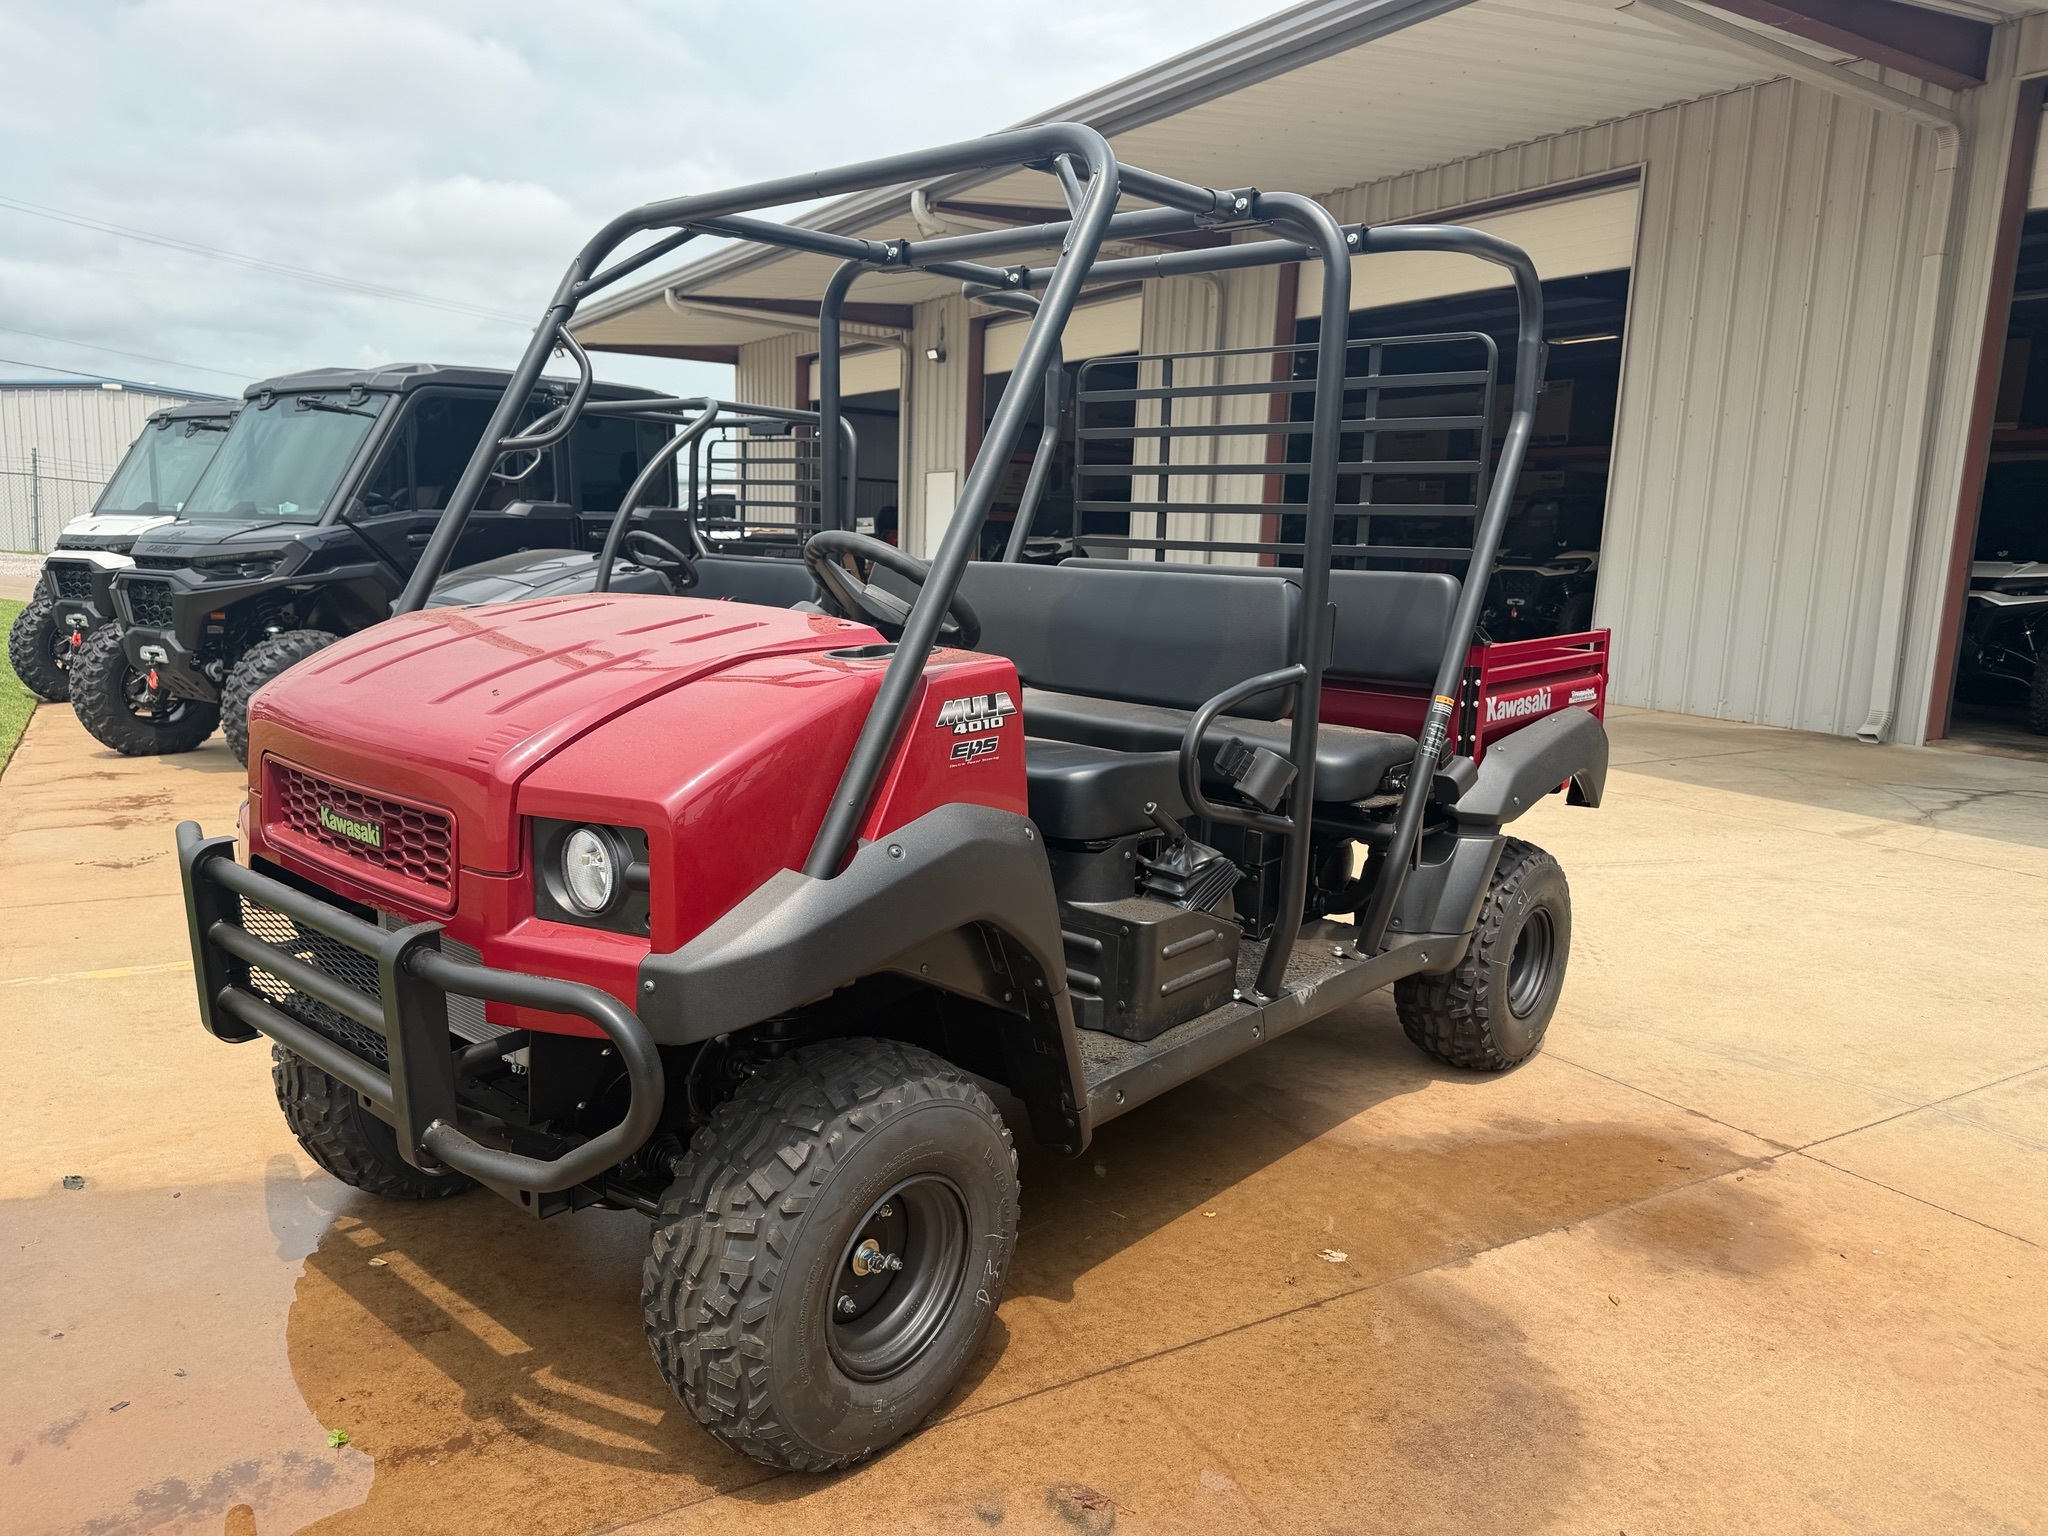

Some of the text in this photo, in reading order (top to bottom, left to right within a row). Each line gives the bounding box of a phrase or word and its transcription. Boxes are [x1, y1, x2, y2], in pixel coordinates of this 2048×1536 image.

[935, 691, 1018, 728] MULE
[1485, 686, 1551, 722] Kawasaki
[953, 716, 1004, 734] 4010
[320, 805, 381, 848] Kawasaki
